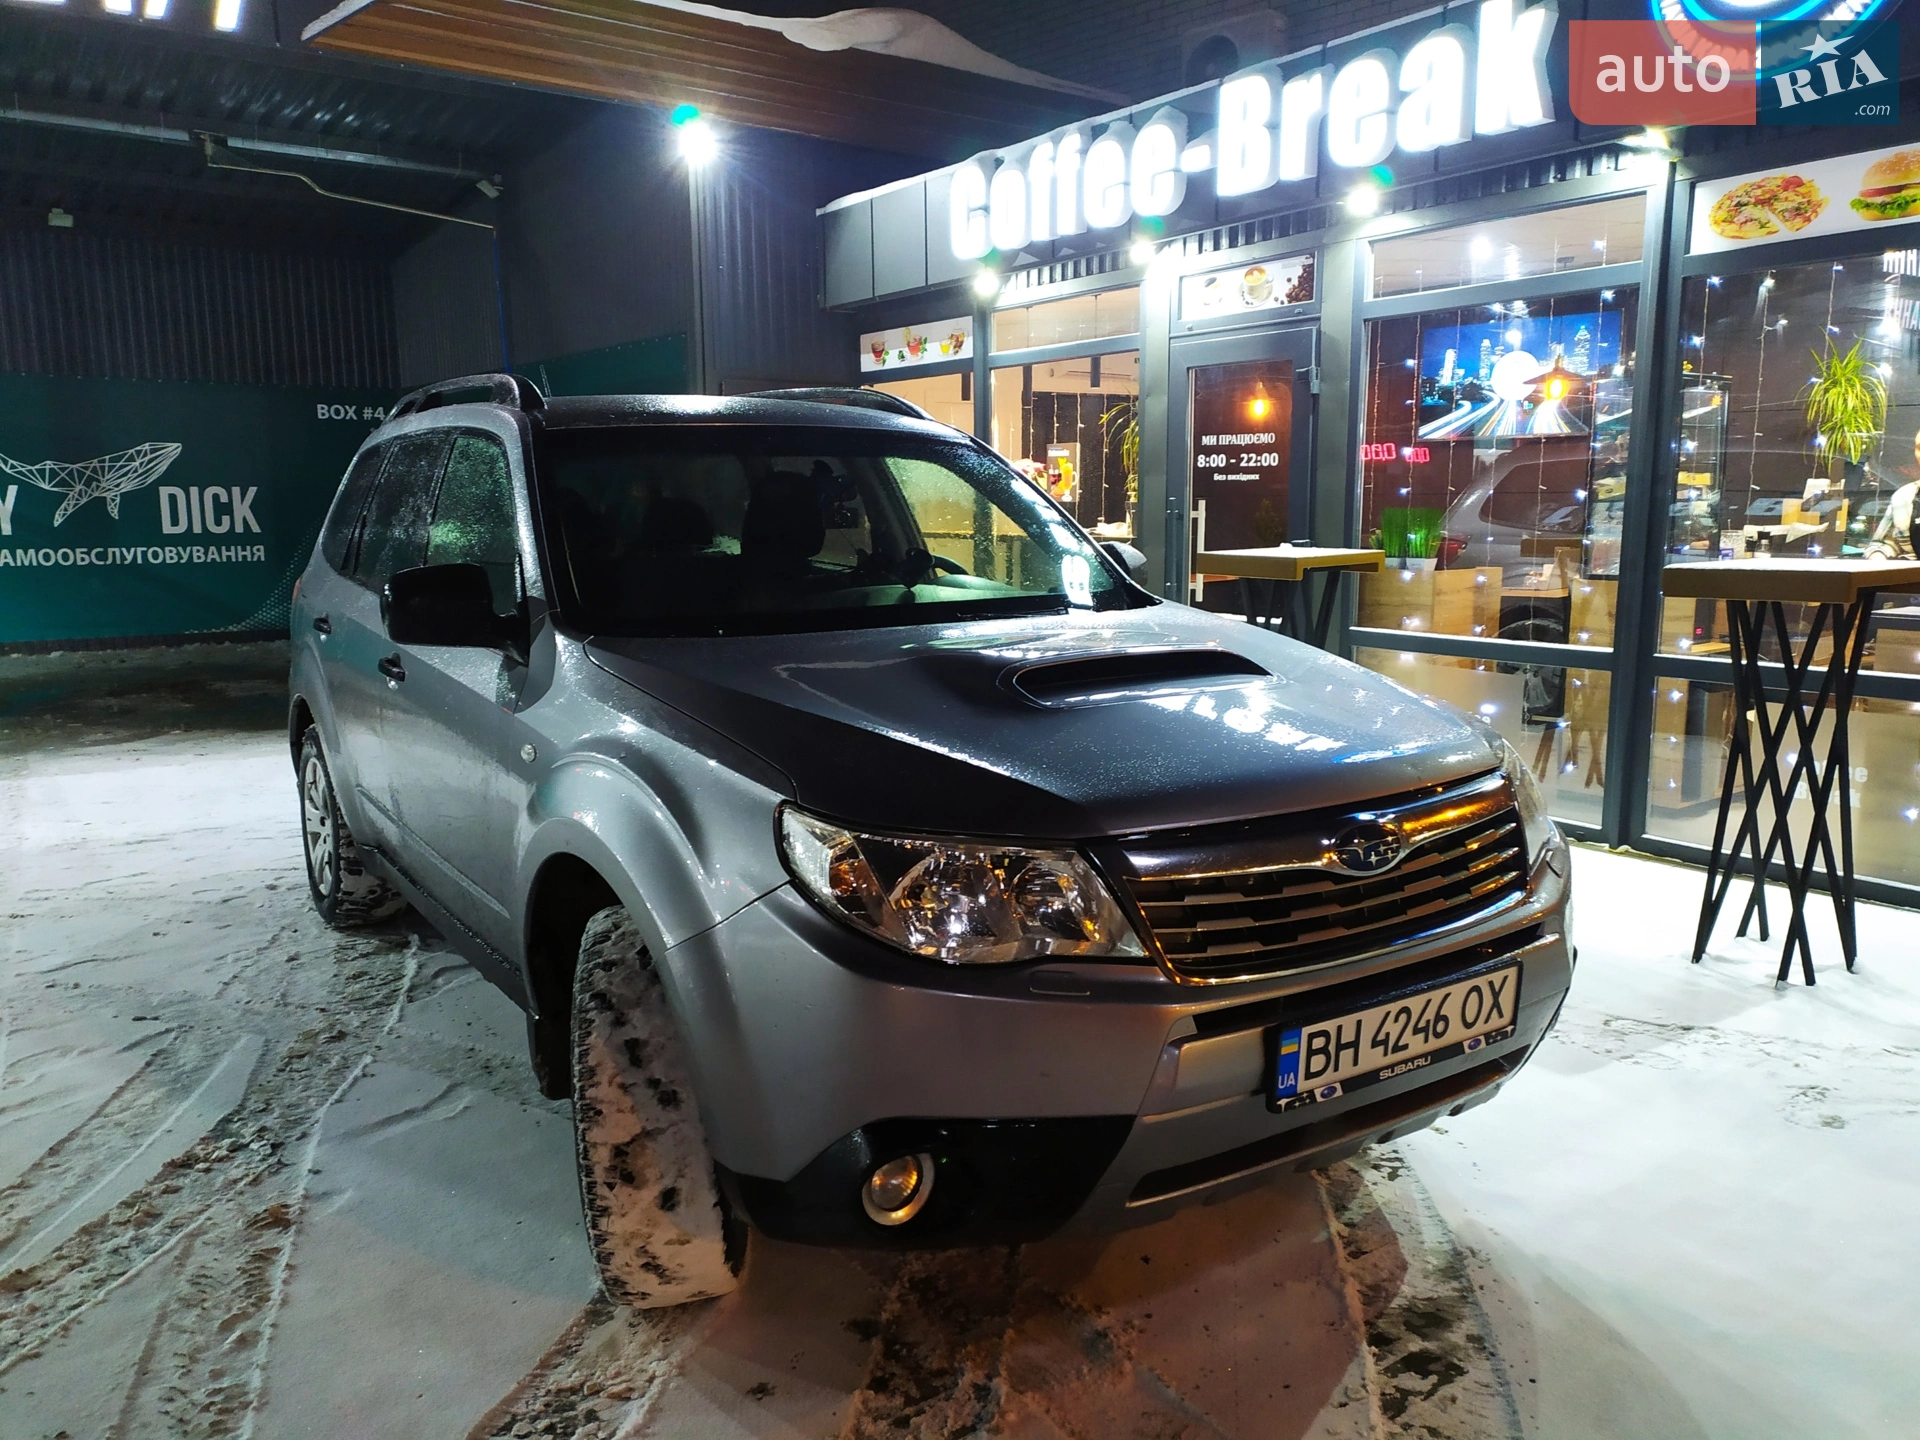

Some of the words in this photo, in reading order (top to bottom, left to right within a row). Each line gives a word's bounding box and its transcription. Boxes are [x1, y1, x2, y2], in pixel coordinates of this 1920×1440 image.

[950, 0, 1557, 260] Coffee-Break
[316, 403, 358, 420] BOX
[362, 406, 386, 421] #4
[1201, 435, 1217, 446] МИ
[1218, 432, 1276, 447] ПРАЦЮЄМО
[1197, 454, 1226, 468] 8:00
[1240, 453, 1279, 467] 22:00
[158, 485, 262, 534] DICK
[1304, 1018, 1362, 1082] BH
[1371, 992, 1452, 1057] 4246
[1461, 975, 1510, 1030] OX
[1379, 1055, 1432, 1081] SUBARU
[1277, 1072, 1296, 1090] UA
